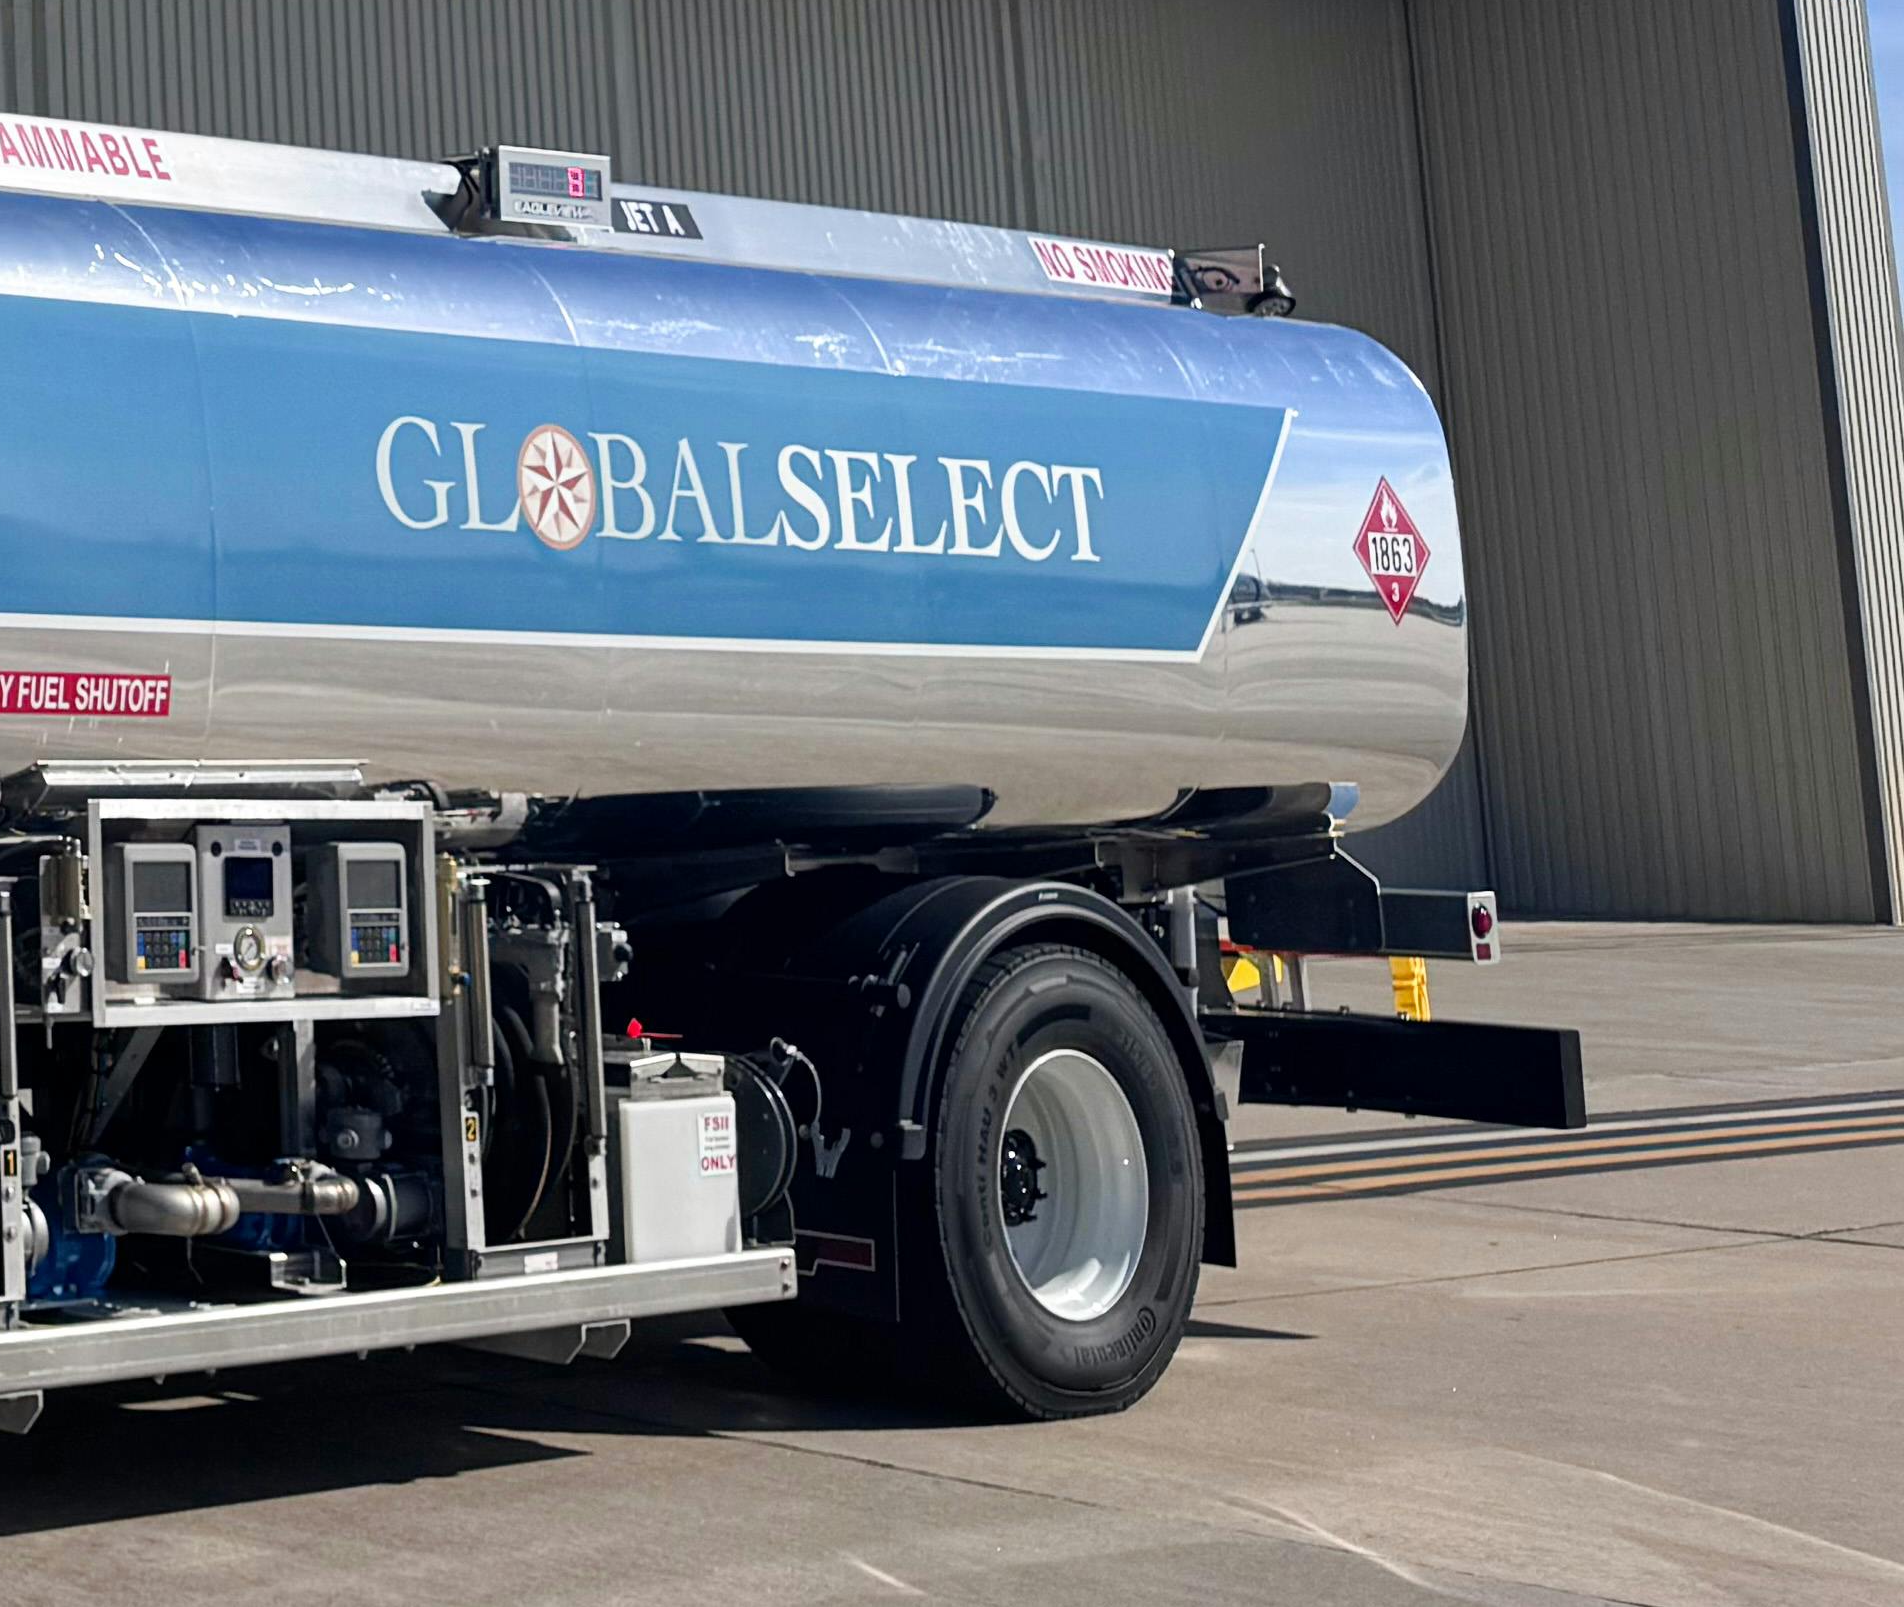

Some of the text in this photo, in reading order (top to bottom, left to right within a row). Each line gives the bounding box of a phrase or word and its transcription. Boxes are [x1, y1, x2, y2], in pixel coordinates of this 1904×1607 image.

[513, 200, 585, 219] EAGLEVIEW
[620, 200, 685, 236] JET A
[1034, 241, 1076, 279] NO
[1371, 536, 1414, 574] 1863
[1391, 581, 1400, 603] 3
[16, 674, 70, 711] FUEL
[74, 676, 170, 713] SHUTOFF
[467, 1118, 475, 1141] 2
[704, 1115, 729, 1132] FSII
[6, 1151, 15, 1175] 1
[701, 1154, 736, 1172] ONLY
